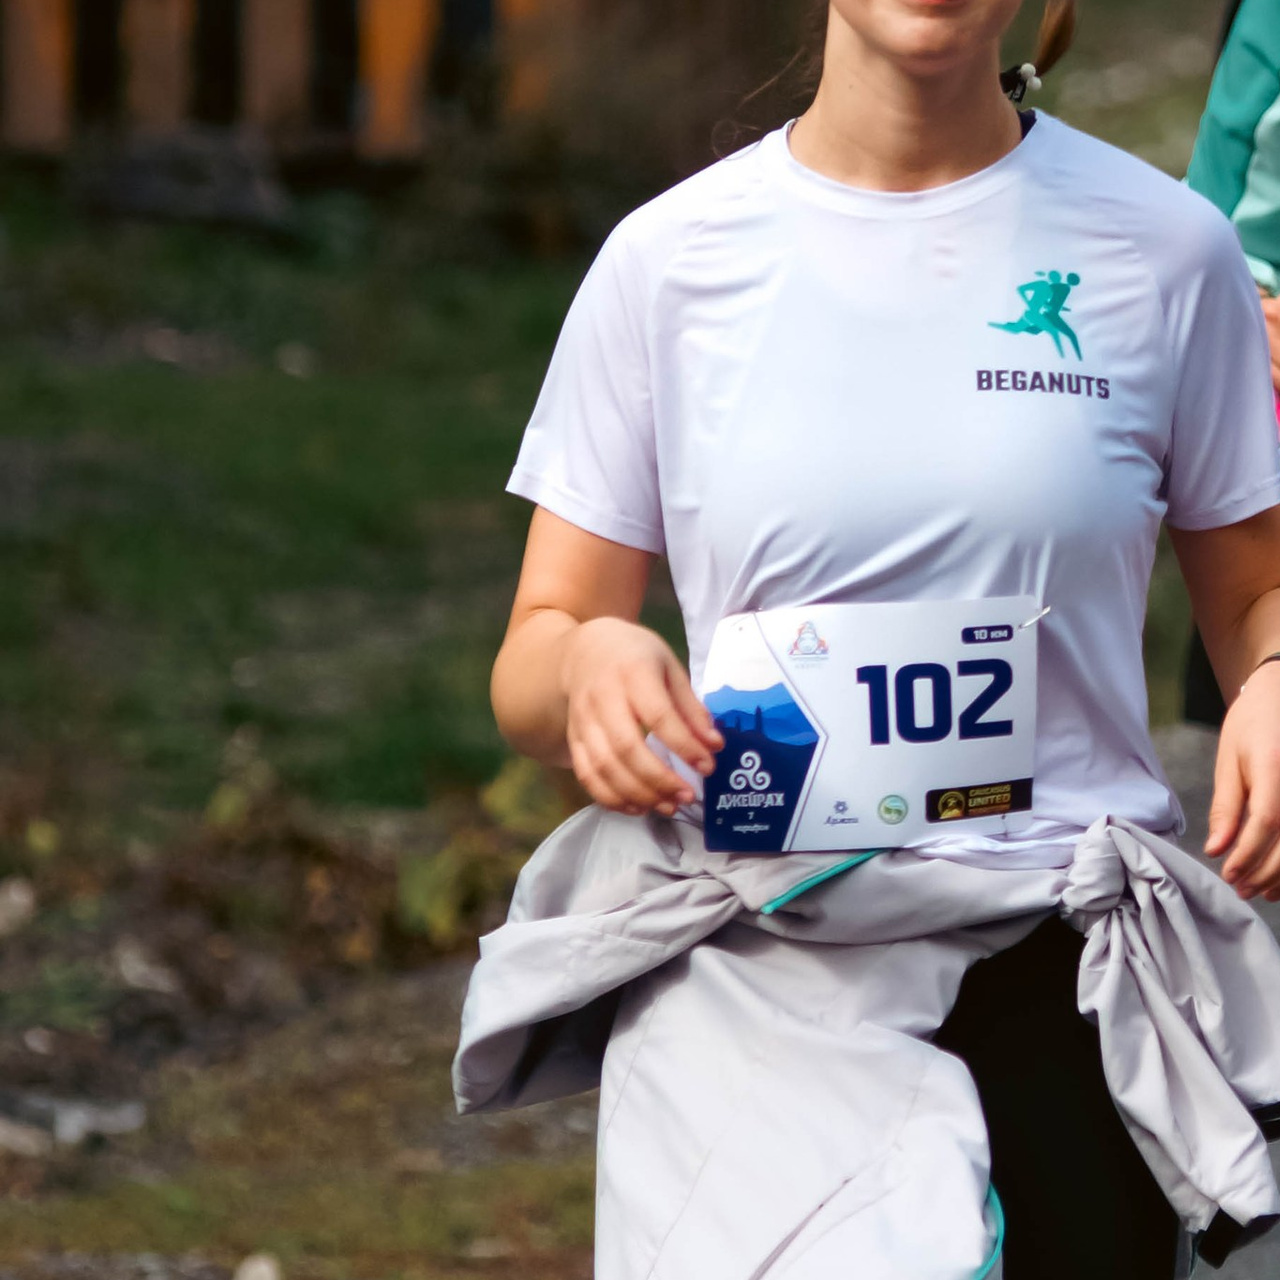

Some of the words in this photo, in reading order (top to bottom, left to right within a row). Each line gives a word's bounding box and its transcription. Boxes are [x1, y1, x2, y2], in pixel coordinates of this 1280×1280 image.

[976, 370, 1110, 400] BEGANUTS
[973, 629, 988, 640] 10
[856, 658, 1014, 746] 102
[716, 792, 785, 811] ДЖЕЙРАХ
[968, 794, 1012, 807] UNITED
